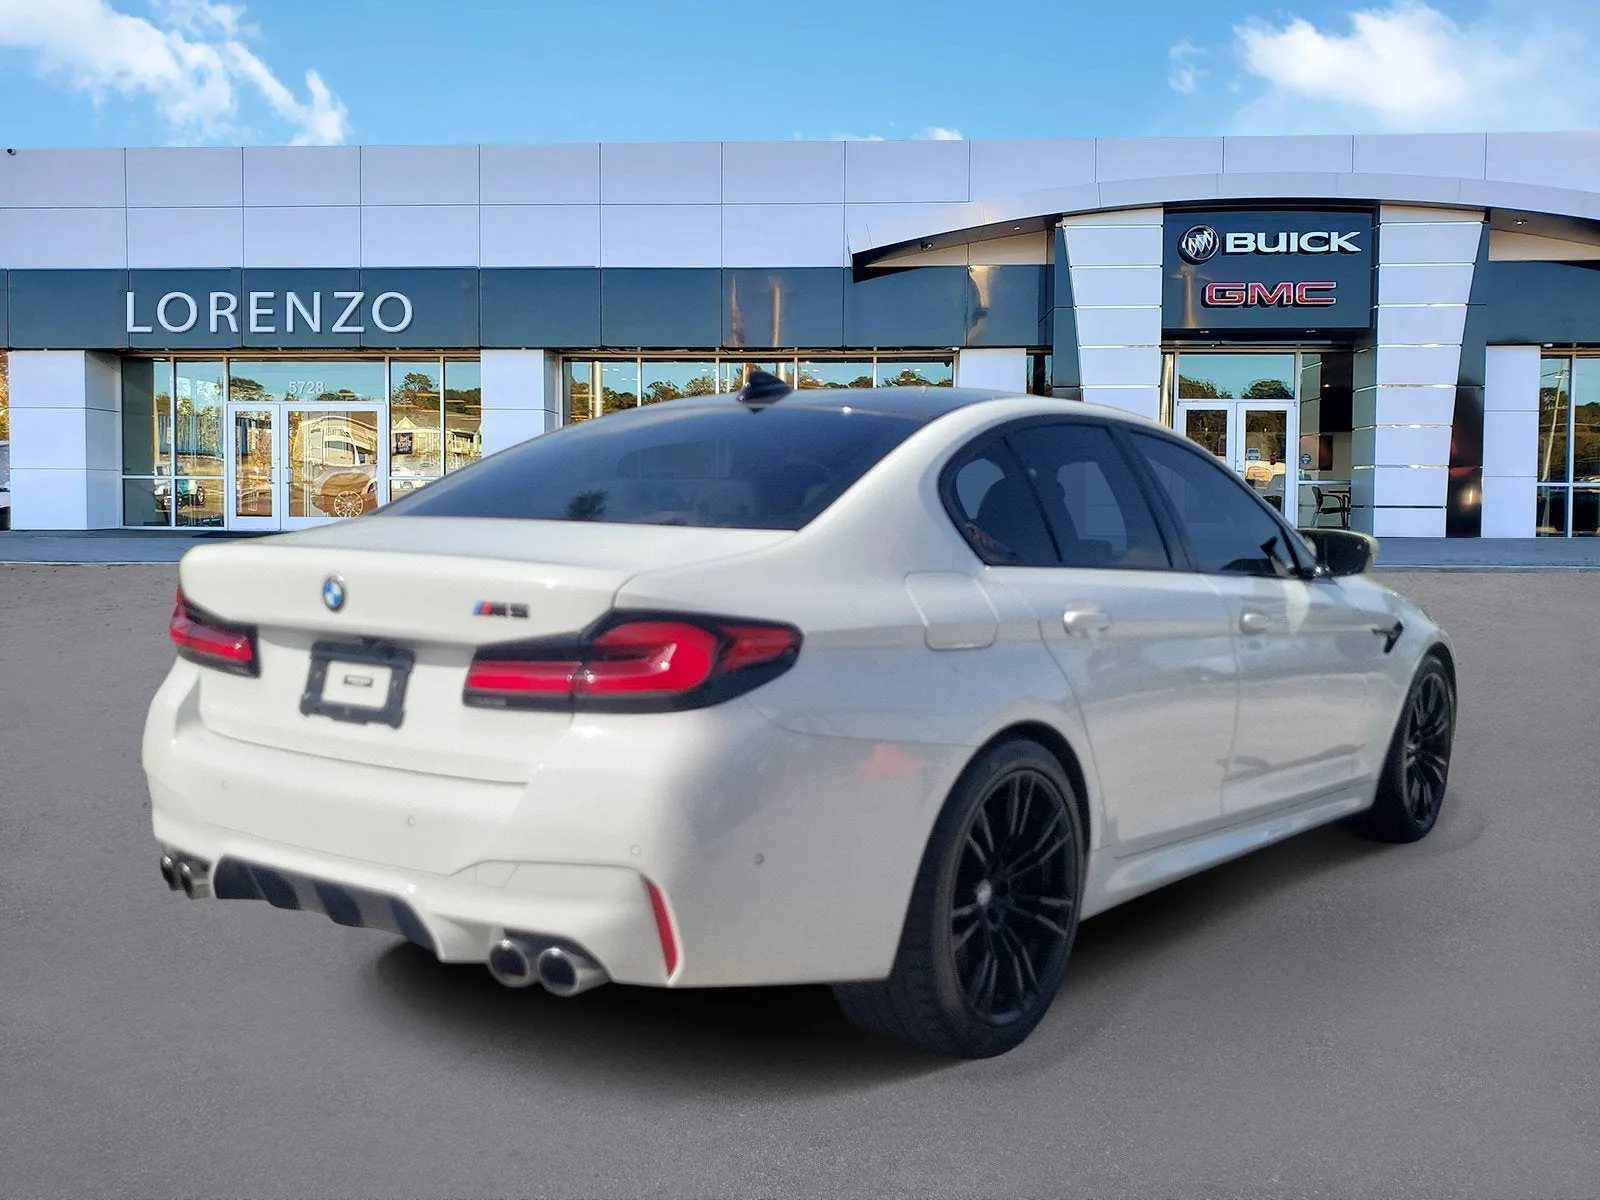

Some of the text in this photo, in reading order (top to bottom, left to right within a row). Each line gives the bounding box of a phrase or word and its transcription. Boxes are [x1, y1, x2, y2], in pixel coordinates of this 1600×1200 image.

[1225, 231, 1361, 254] BUICK
[1204, 281, 1337, 307] GMC
[126, 291, 413, 334] LORENZO
[288, 380, 325, 394] 5728
